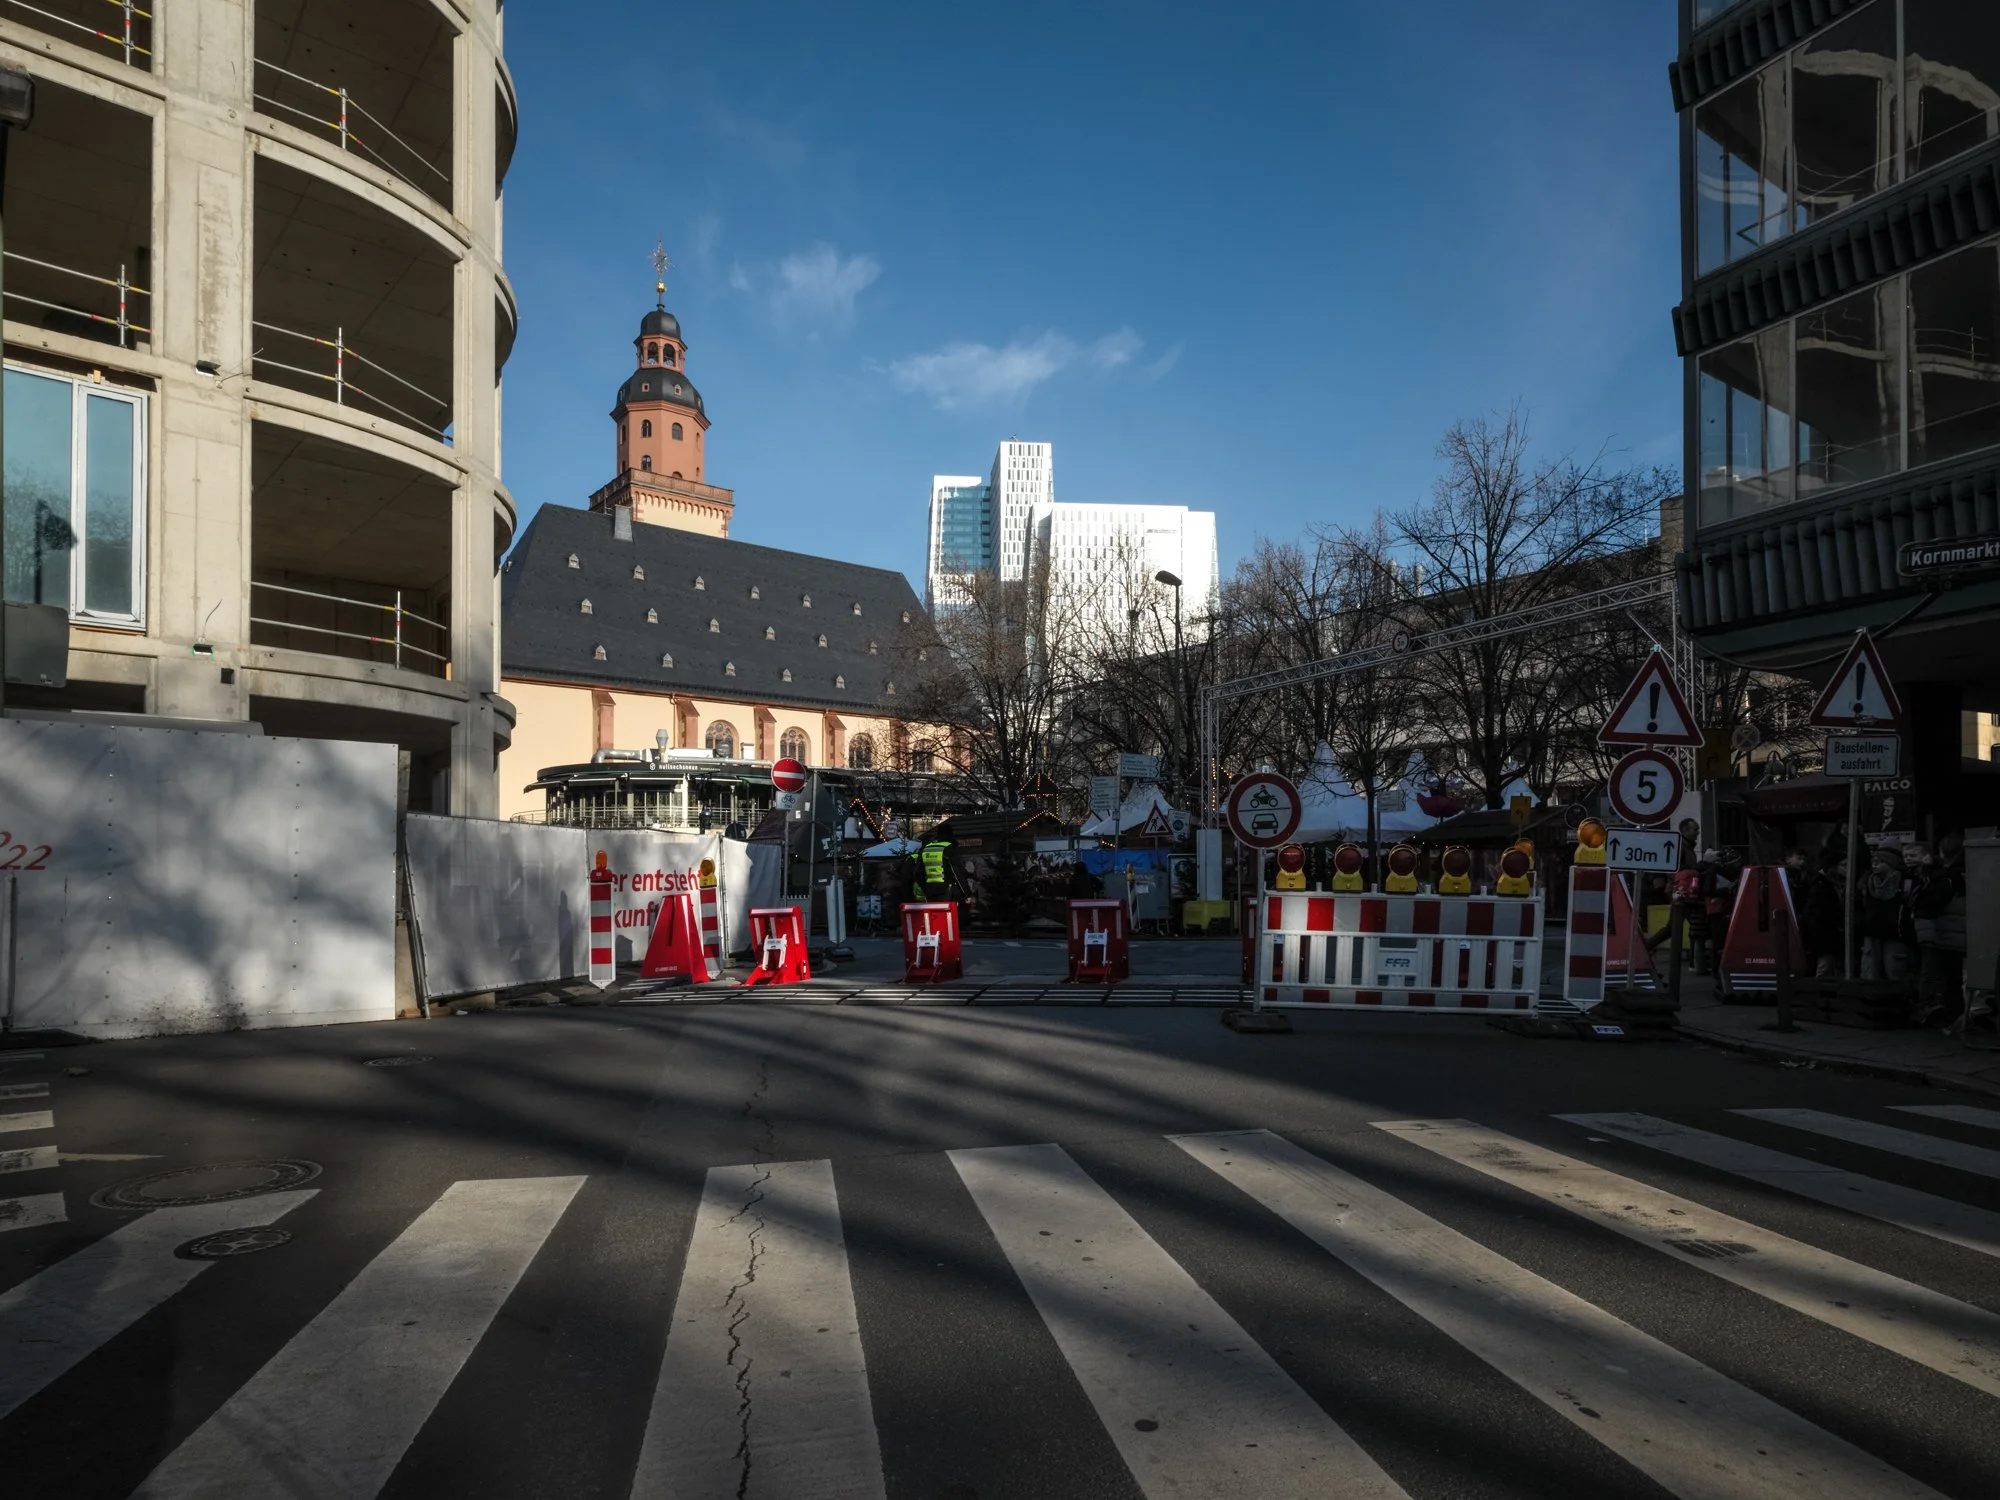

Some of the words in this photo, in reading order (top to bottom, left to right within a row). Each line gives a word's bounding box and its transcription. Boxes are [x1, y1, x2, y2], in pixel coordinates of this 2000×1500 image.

[1911, 542, 2000, 566] Kornmarkt
[1834, 742, 1889, 755] Baustellen-
[1840, 758, 1881, 770] ausfahrt
[1636, 770, 1658, 804] 5
[1863, 779, 1911, 792] FALCO
[1624, 847, 1658, 862] 30m
